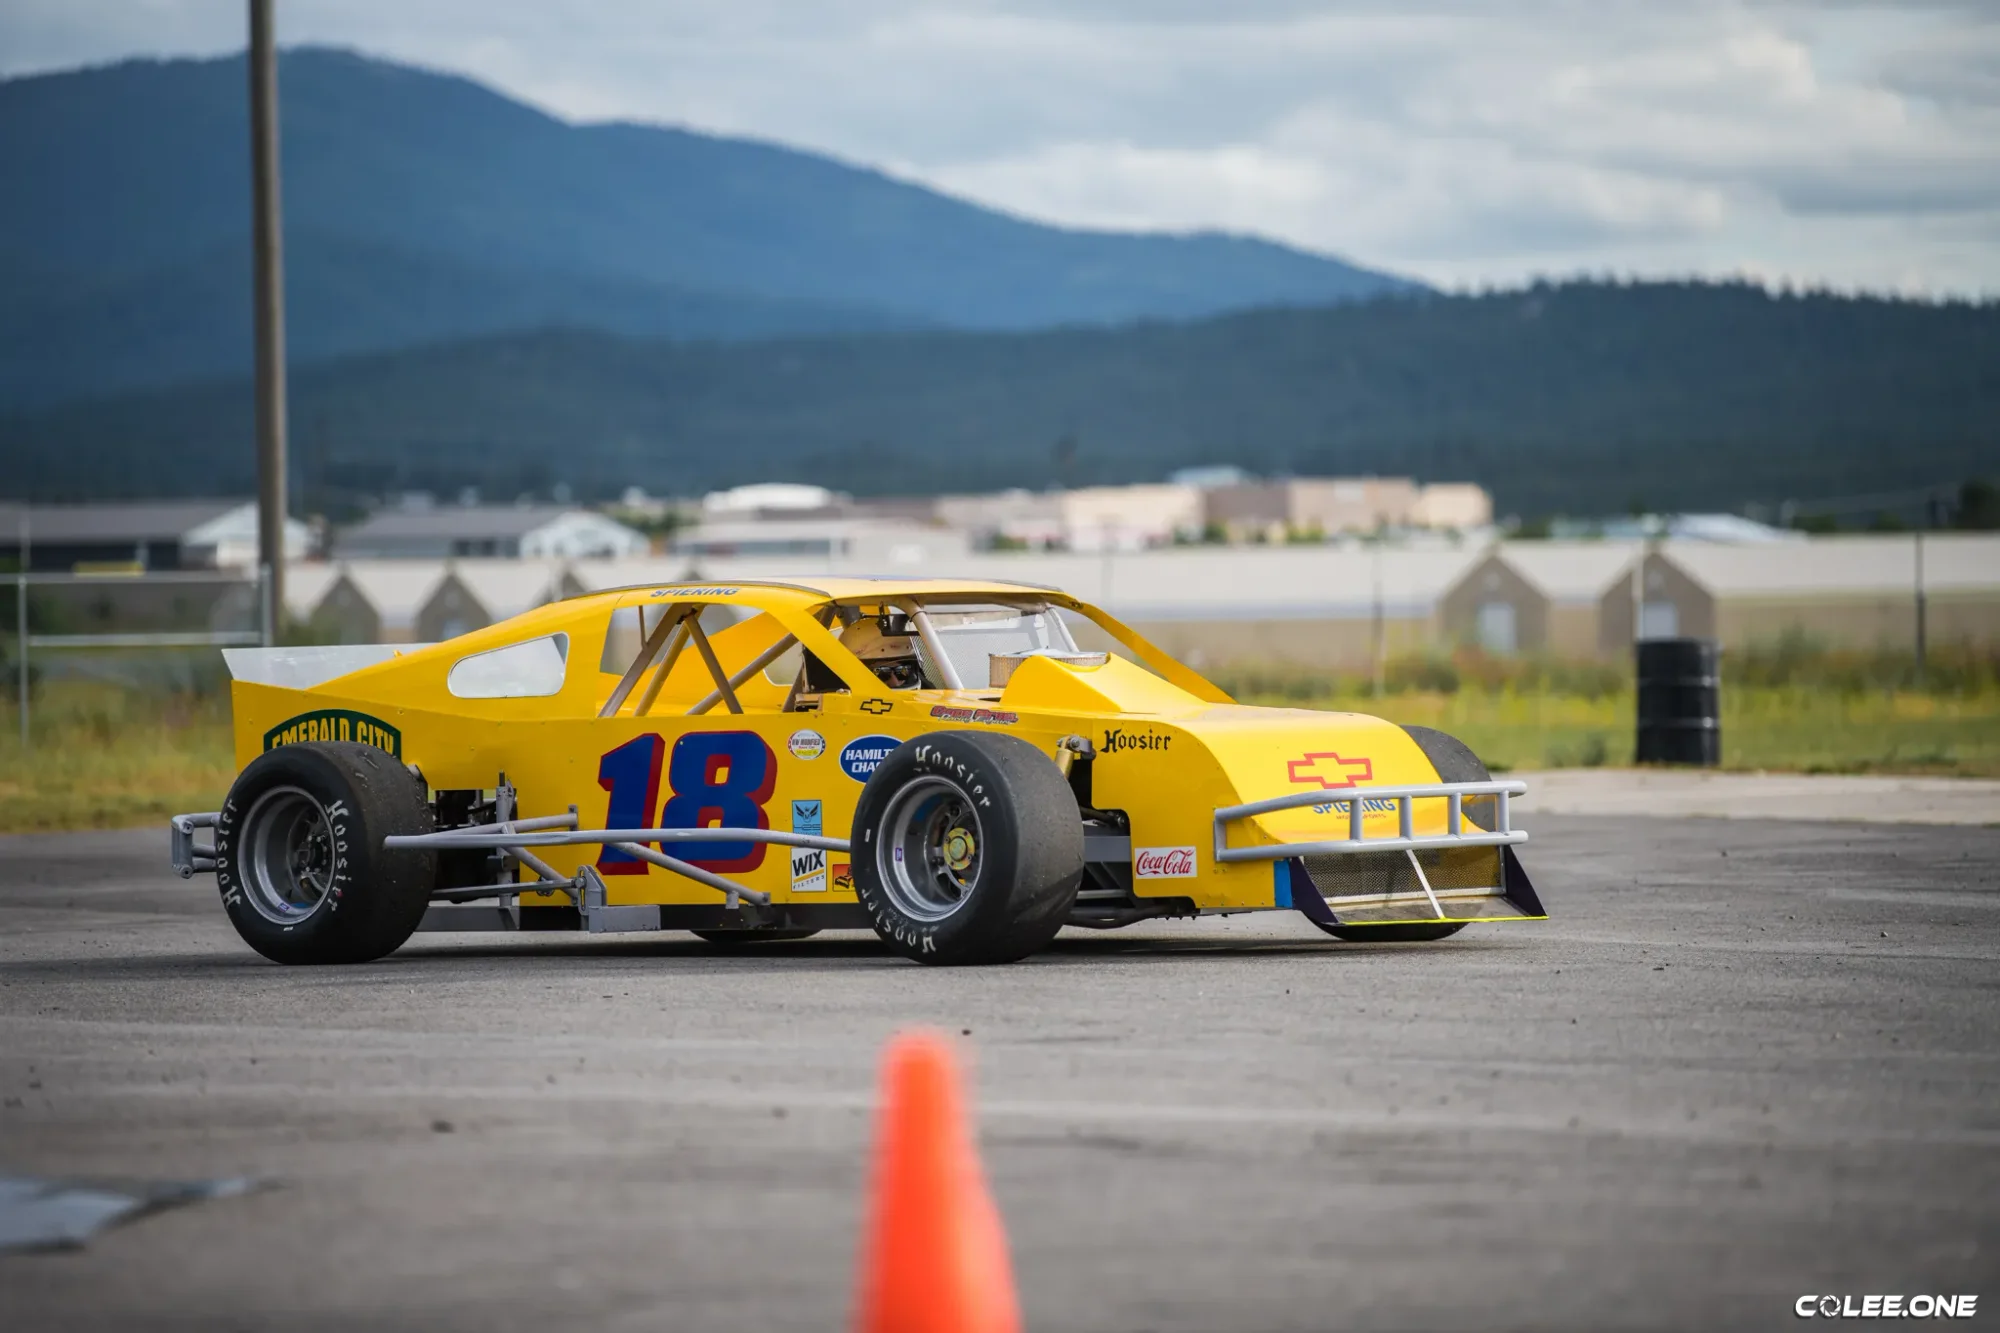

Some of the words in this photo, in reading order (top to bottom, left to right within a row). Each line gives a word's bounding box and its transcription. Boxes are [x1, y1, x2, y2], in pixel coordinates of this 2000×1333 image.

[272, 717, 350, 749] EMERALD
[357, 720, 394, 755] CITY
[1100, 728, 1172, 753] Hoosier
[915, 745, 991, 807] Hoosier
[595, 730, 778, 876] 18
[1312, 797, 1396, 815] SPIEING
[792, 850, 824, 877] WIX
[1135, 849, 1193, 876] Coca-Cola
[792, 874, 825, 890] FILTERS
